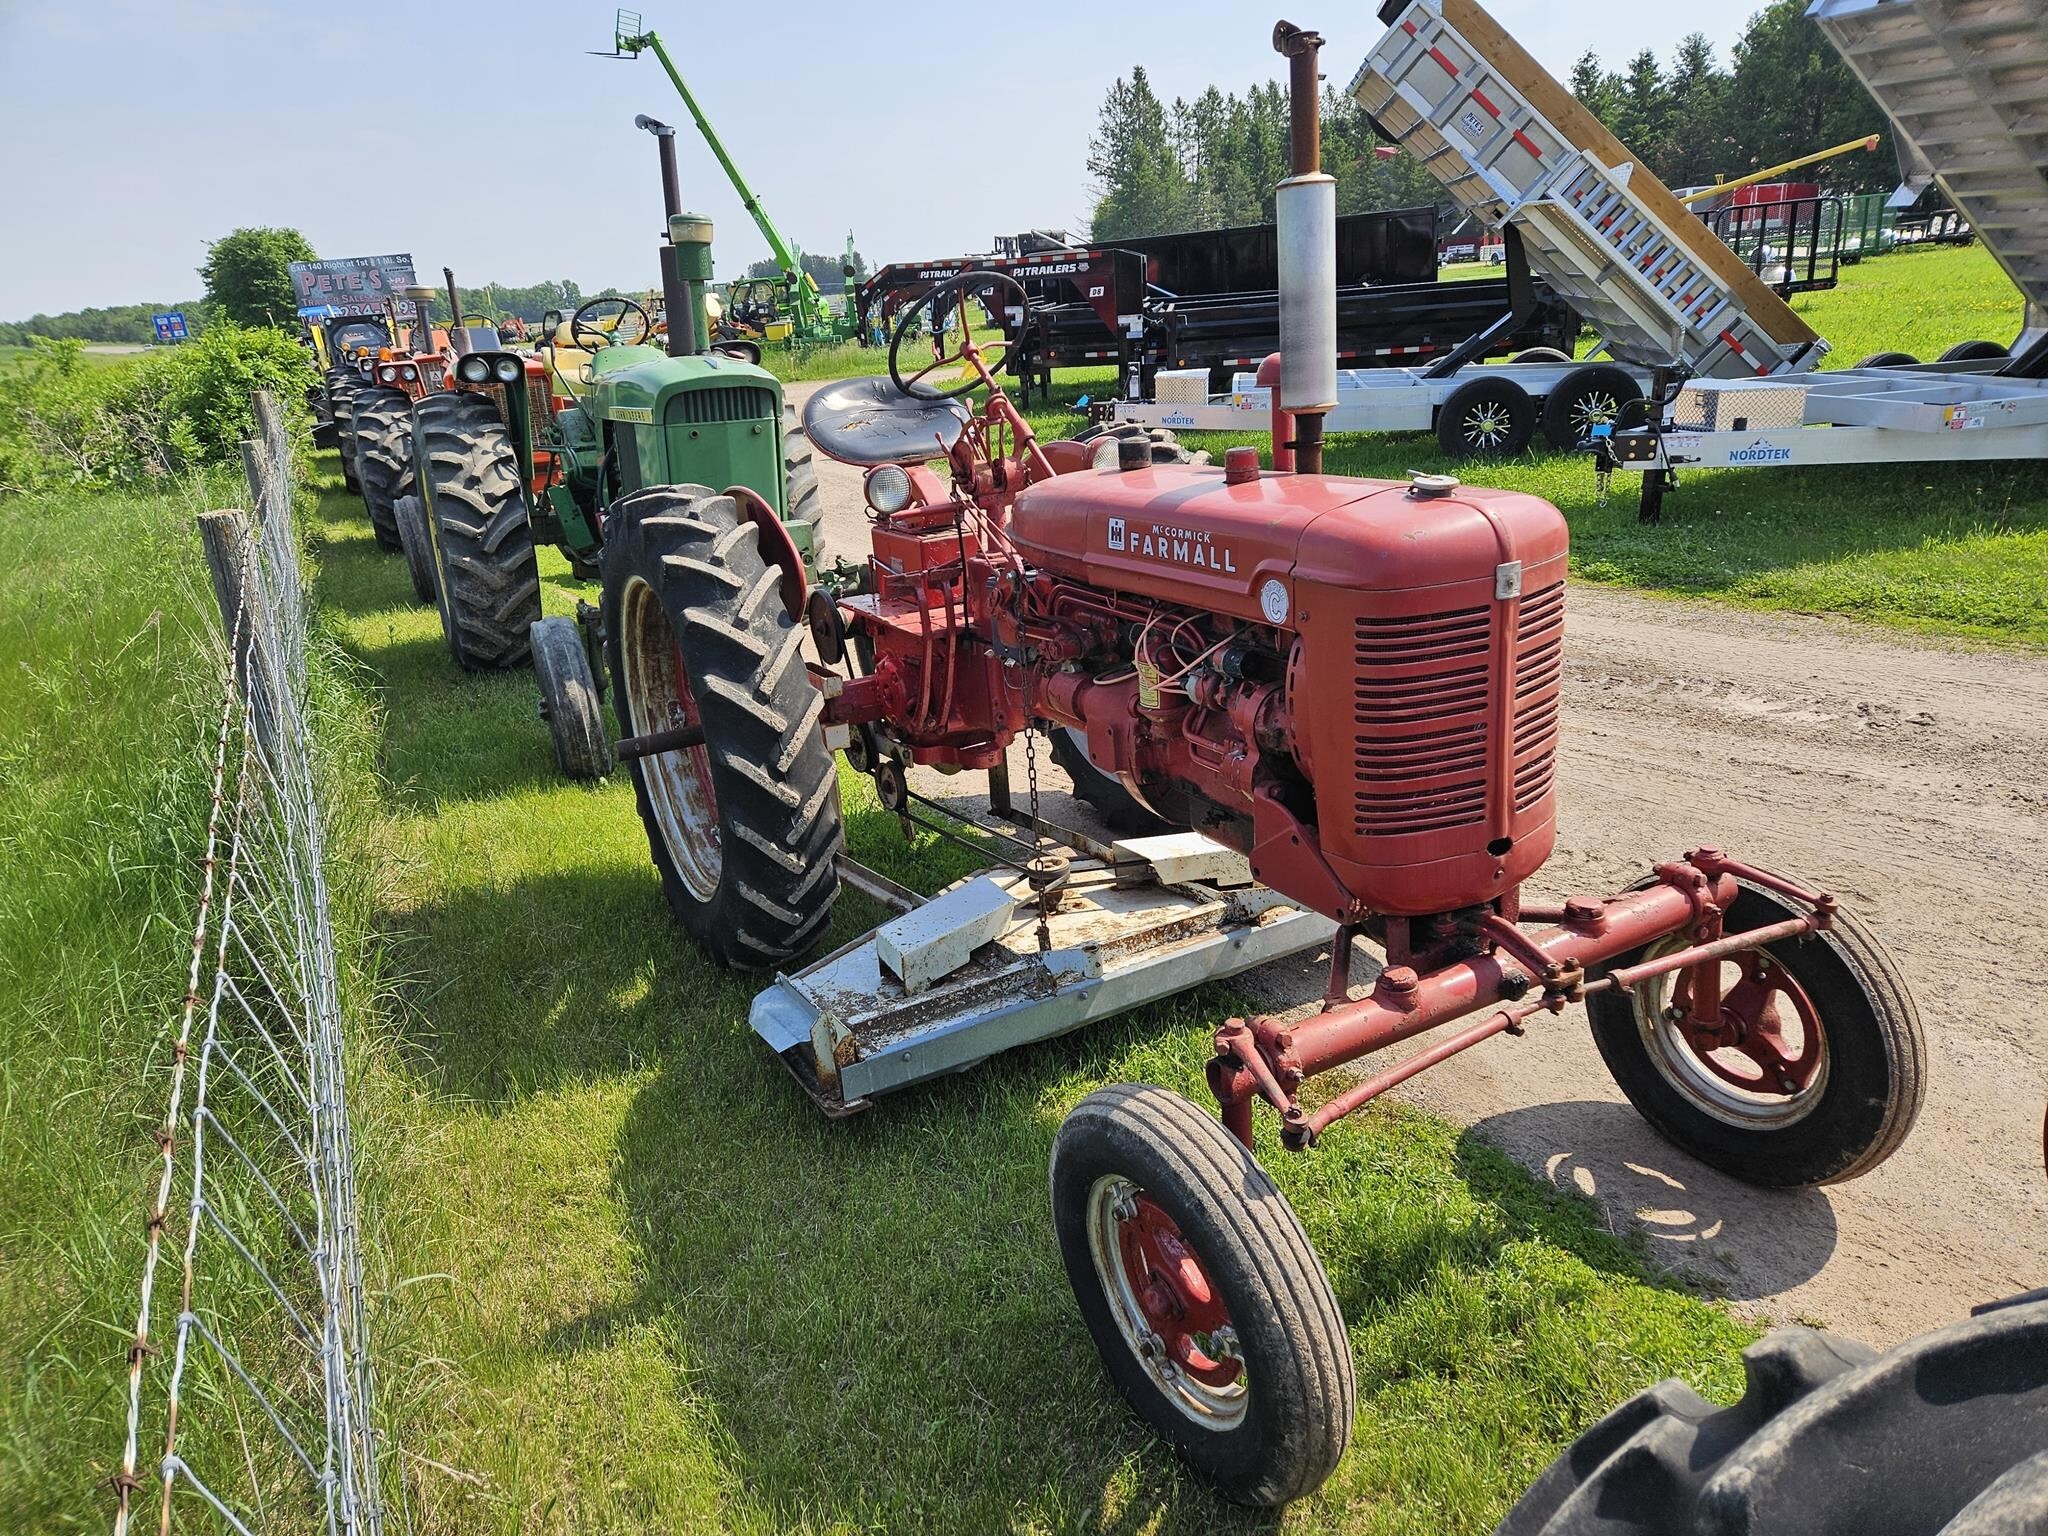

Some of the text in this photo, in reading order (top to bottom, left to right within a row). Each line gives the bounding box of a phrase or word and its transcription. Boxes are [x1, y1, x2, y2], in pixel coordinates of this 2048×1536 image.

[291, 264, 307, 272] Exit
[308, 262, 322, 271] 140
[323, 260, 345, 271] Right
[346, 259, 355, 268] at
[355, 258, 369, 267] 1st
[396, 255, 410, 264] So.
[300, 270, 382, 296] PETE'S
[1161, 416, 1195, 425] NORDTEK
[1729, 448, 1791, 461] NORDTEK
[1130, 532, 1236, 573] FARMALL
